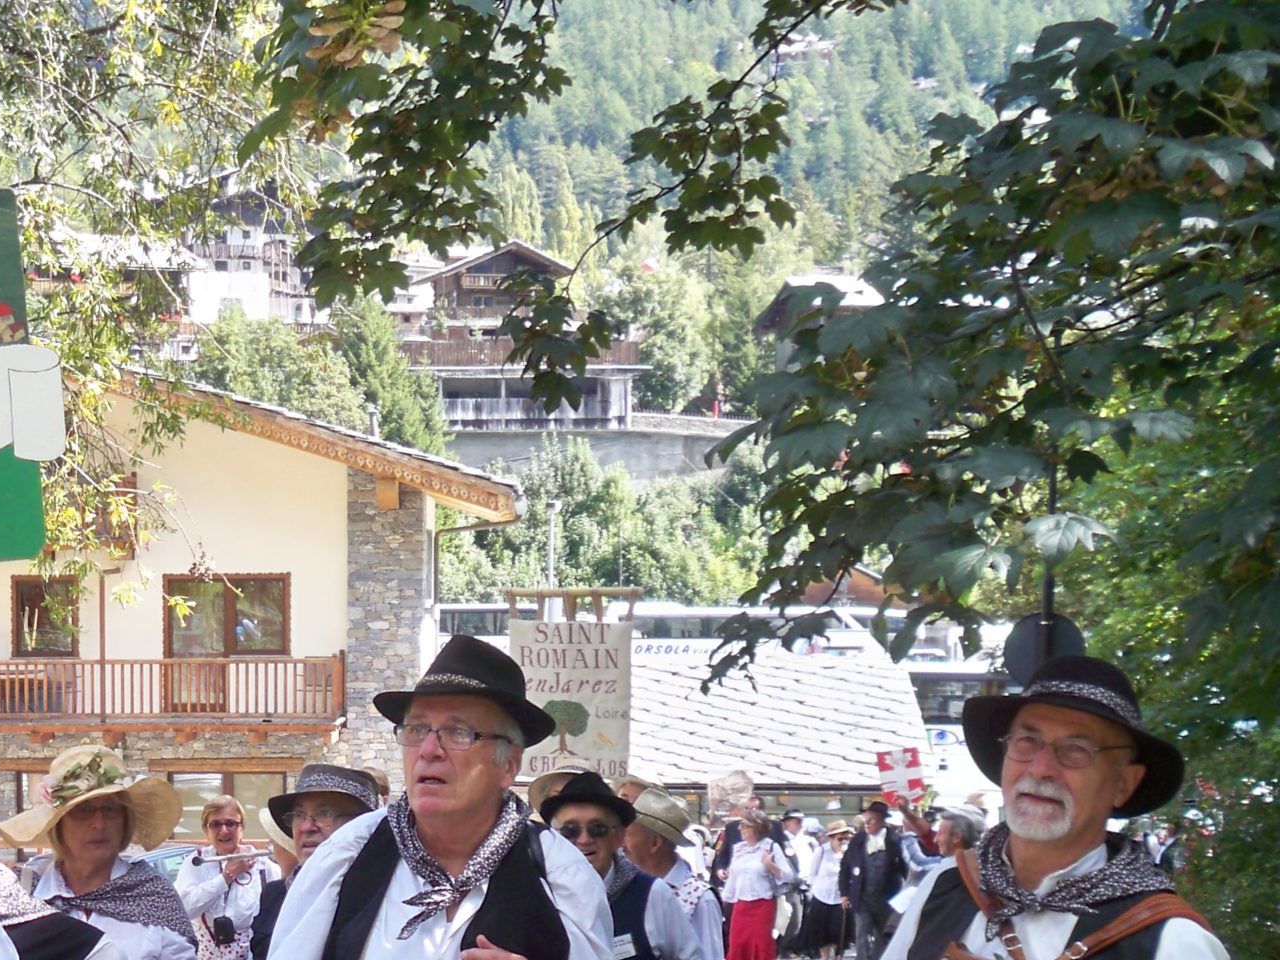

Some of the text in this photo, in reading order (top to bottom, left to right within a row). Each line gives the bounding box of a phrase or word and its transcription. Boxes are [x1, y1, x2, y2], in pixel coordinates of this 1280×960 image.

[535, 622, 610, 644] SAINT
[520, 645, 619, 669] ROMAIN
[634, 644, 690, 655] ORSOLA
[595, 705, 630, 720] Loire
